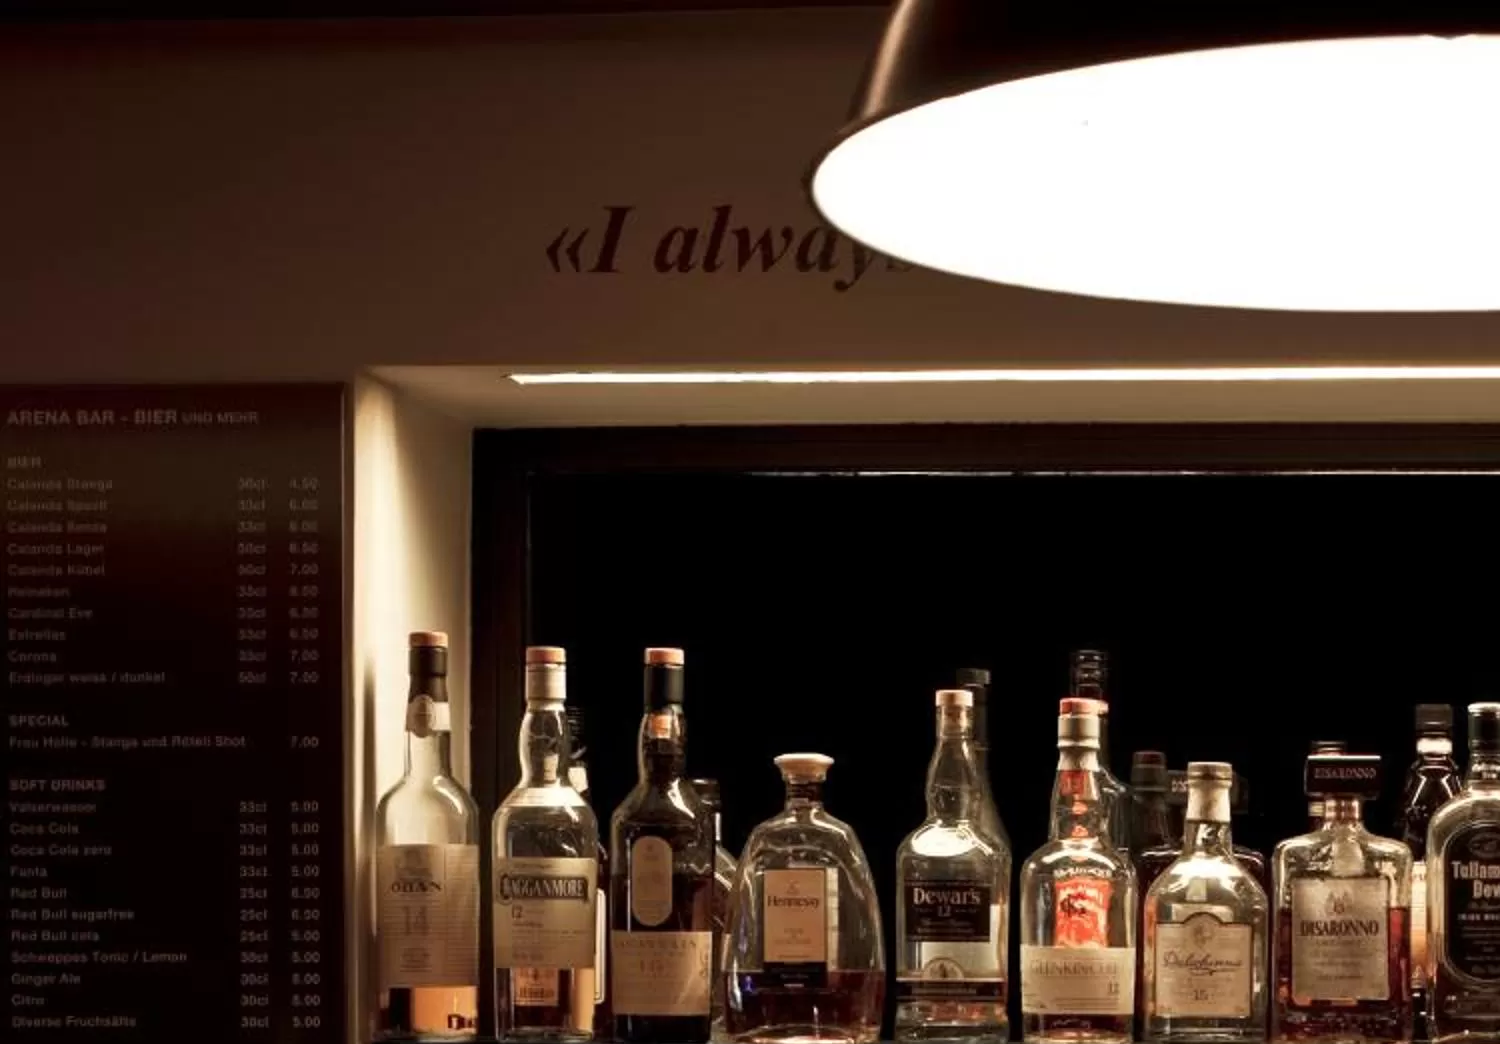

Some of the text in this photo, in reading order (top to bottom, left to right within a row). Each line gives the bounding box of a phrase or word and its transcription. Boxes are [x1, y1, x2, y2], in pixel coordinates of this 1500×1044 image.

[653, 204, 917, 292] alway
[7, 410, 71, 425] ARENA
[912, 887, 981, 905] Dewar's
[1300, 919, 1379, 937] DISARONNO
